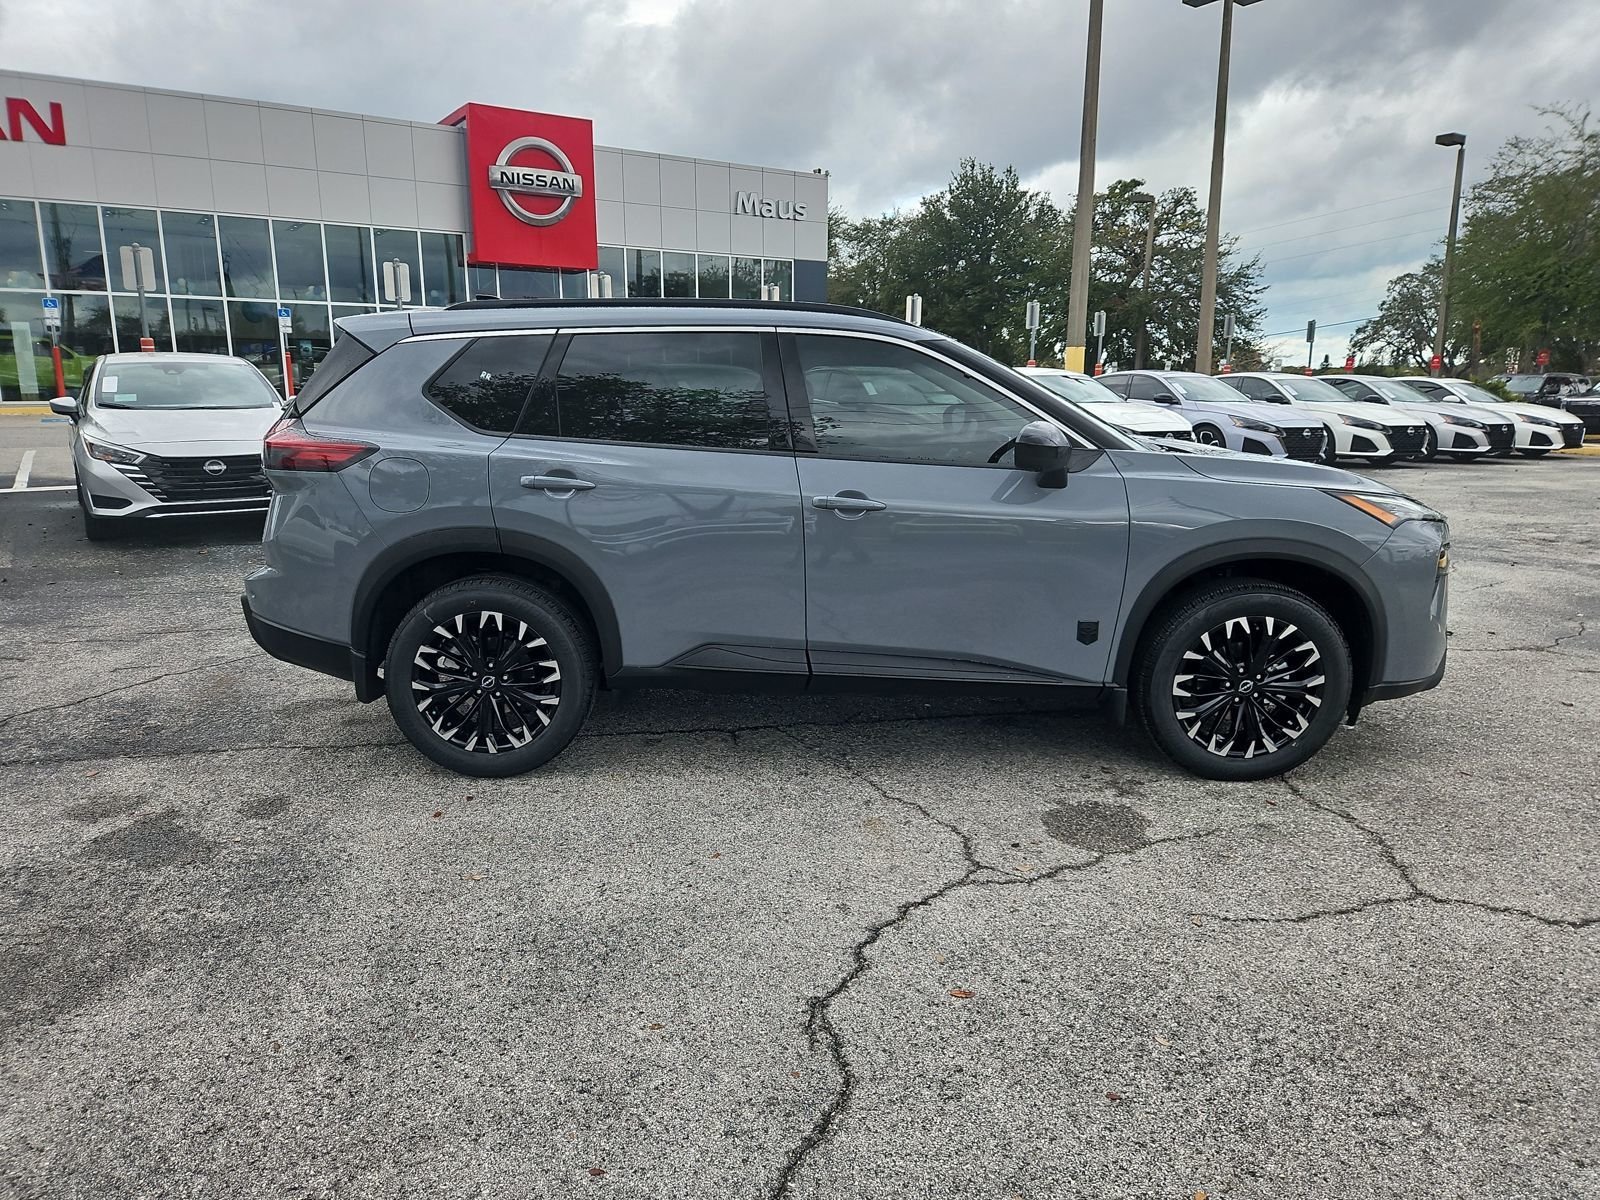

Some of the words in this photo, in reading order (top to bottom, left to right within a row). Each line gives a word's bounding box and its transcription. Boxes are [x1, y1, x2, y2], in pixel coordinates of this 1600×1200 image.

[0, 96, 66, 146] N
[500, 171, 575, 191] NISSAN
[736, 191, 807, 221] Maus
